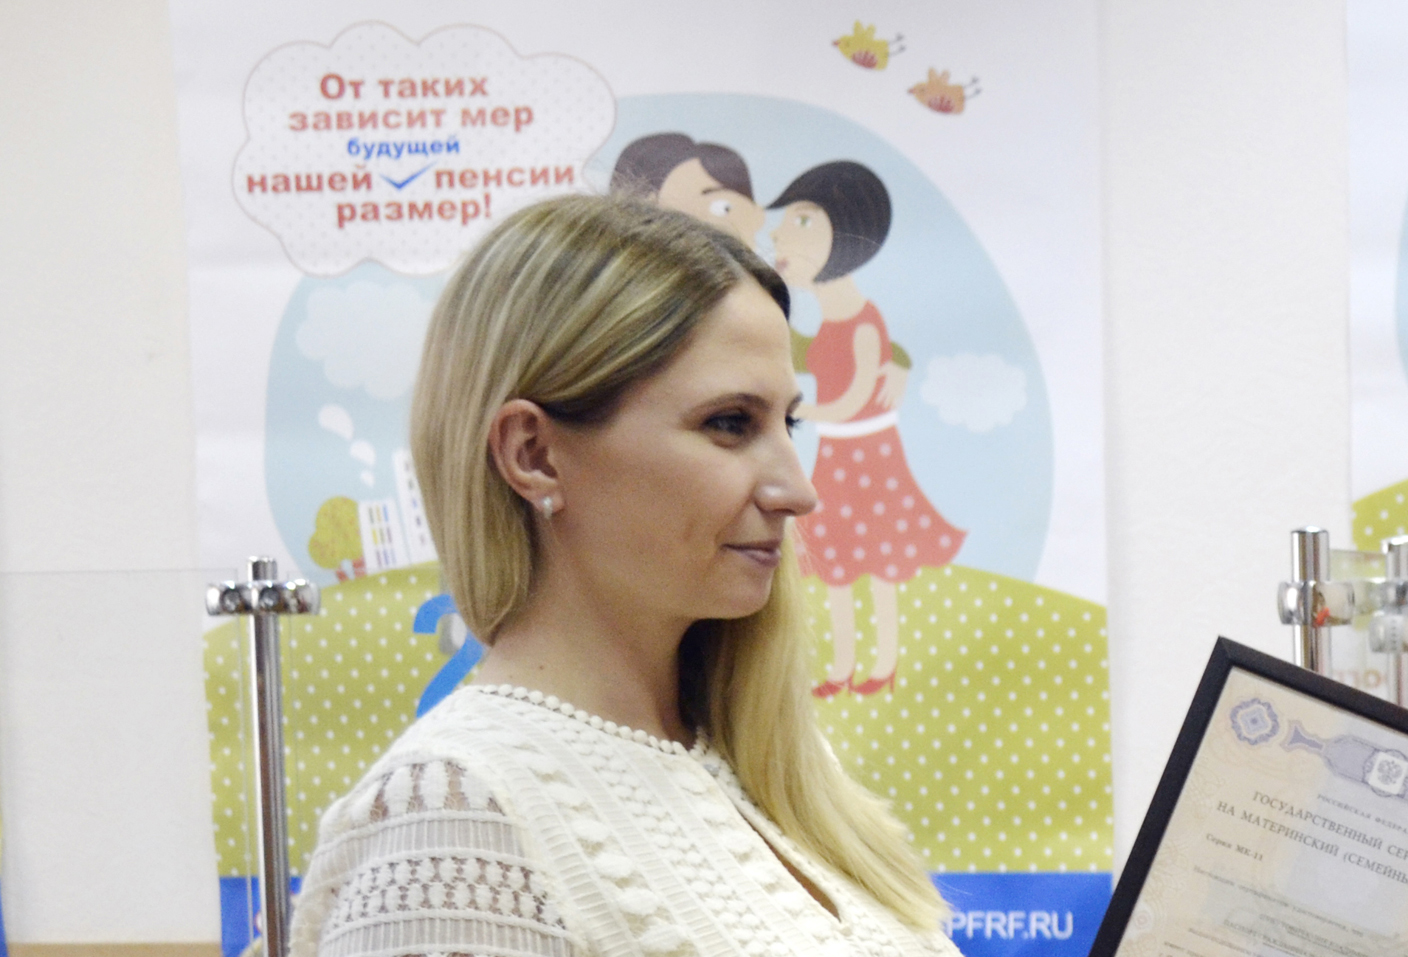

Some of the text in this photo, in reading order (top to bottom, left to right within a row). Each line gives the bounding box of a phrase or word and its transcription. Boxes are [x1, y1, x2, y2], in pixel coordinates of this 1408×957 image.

[319, 73, 489, 99] От таких
[289, 105, 534, 132] зависит мер
[347, 135, 460, 160] будущей
[247, 165, 575, 193] нашей пенсии
[337, 195, 492, 228] размер!
[1215, 799, 1238, 817] НА
[1239, 808, 1340, 857] МАТЕРИНСКИЙ
[1251, 789, 1384, 851] ГОСУДАРСТВЕННЫЙ
